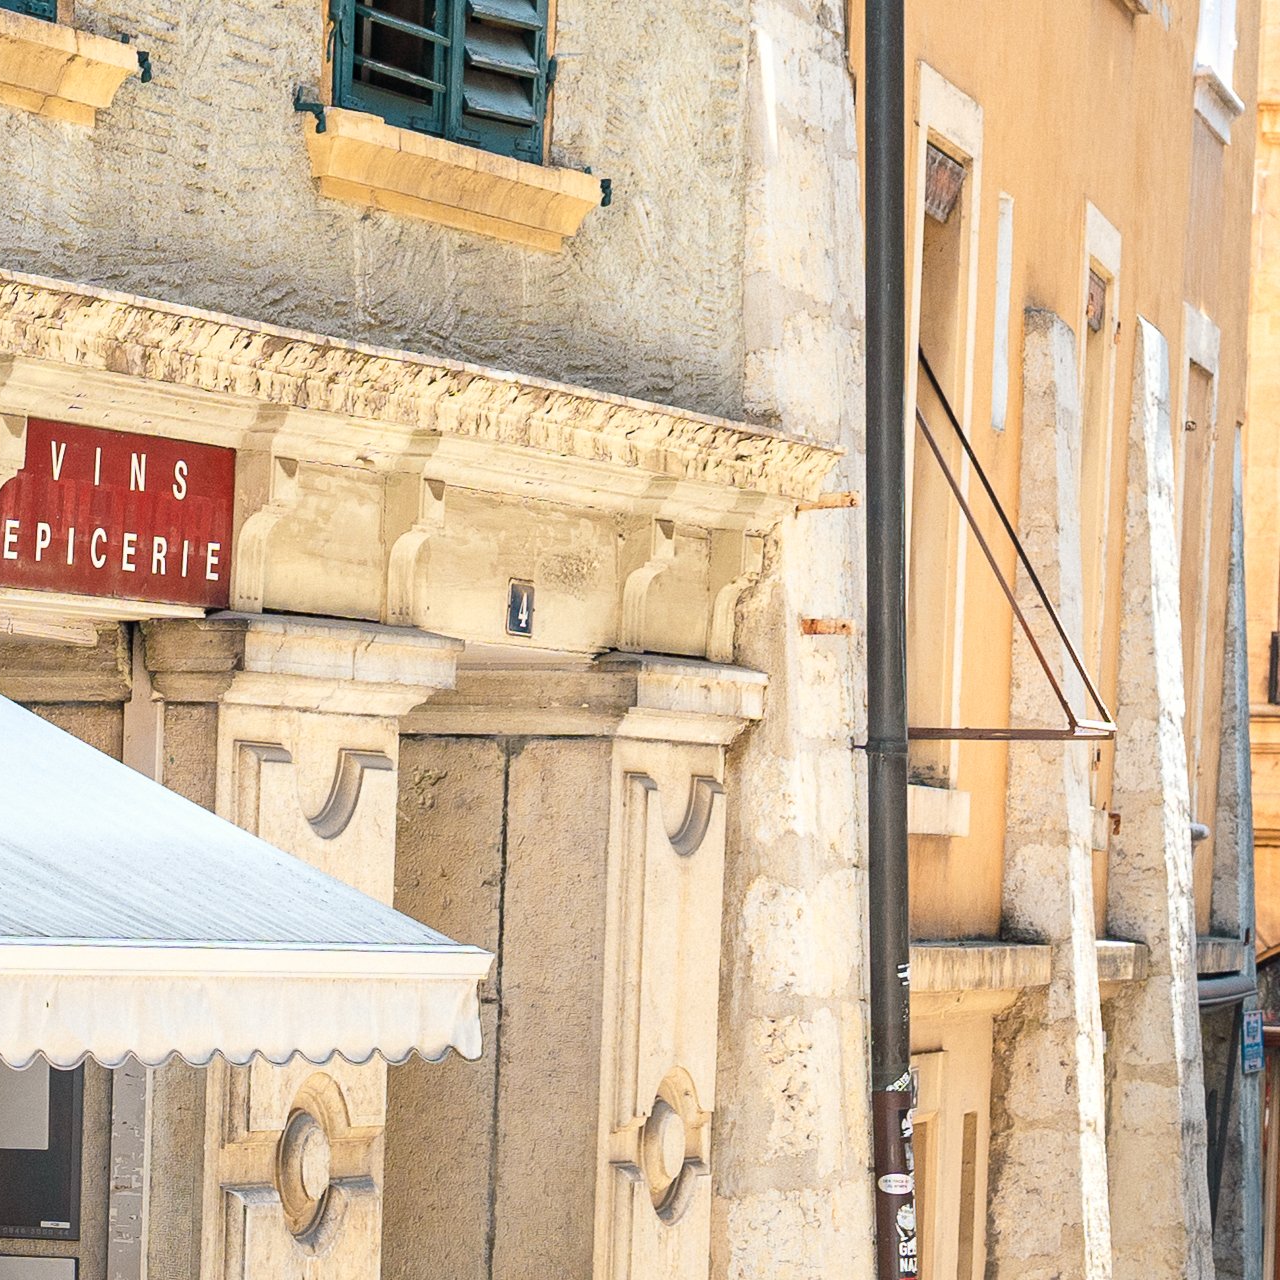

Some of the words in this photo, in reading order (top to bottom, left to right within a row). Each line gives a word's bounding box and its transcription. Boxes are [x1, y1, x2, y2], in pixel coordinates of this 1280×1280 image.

[50, 440, 189, 502] VINS
[3, 518, 221, 583] EPICERIE
[518, 591, 529, 628] 4
